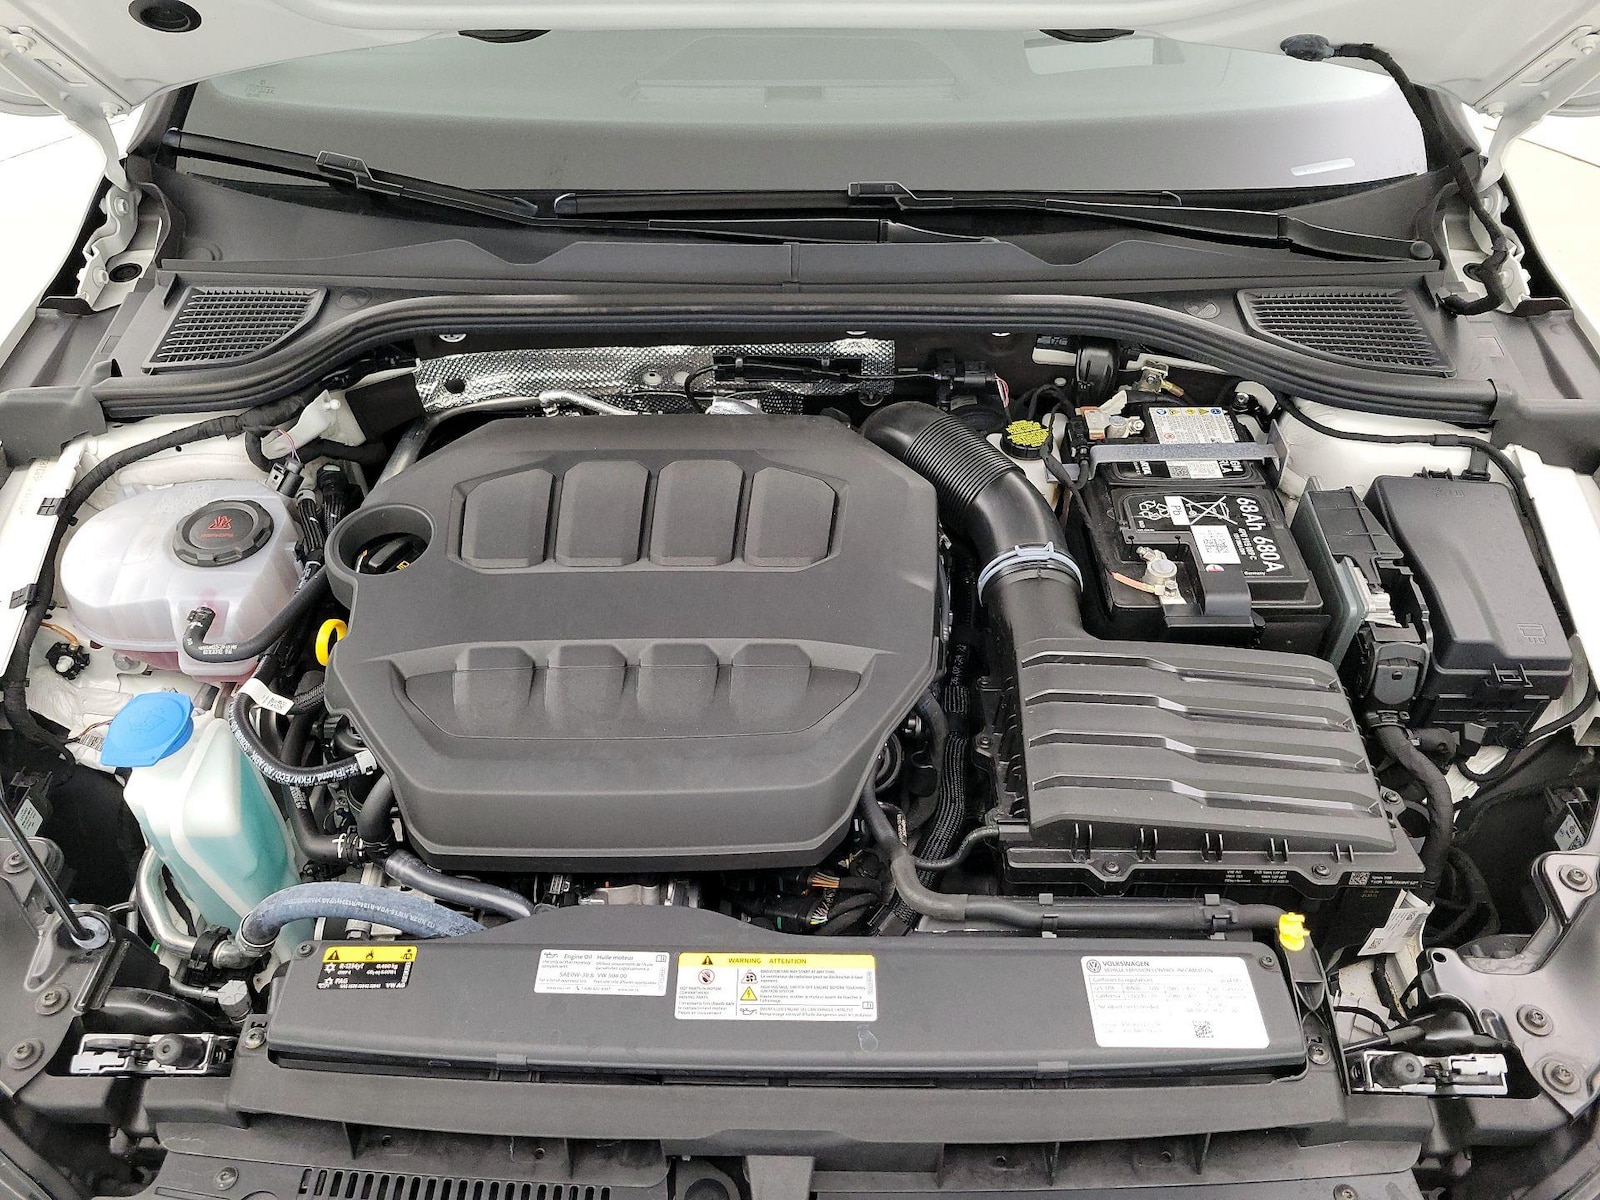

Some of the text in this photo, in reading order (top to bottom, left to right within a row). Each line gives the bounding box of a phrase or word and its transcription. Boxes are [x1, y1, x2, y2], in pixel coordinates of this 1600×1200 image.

[1217, 460, 1232, 474] RLA
[1231, 460, 1243, 472] GM
[1172, 504, 1181, 516] Pb
[1236, 496, 1266, 531] 68Ah
[1253, 536, 1285, 572] 680A
